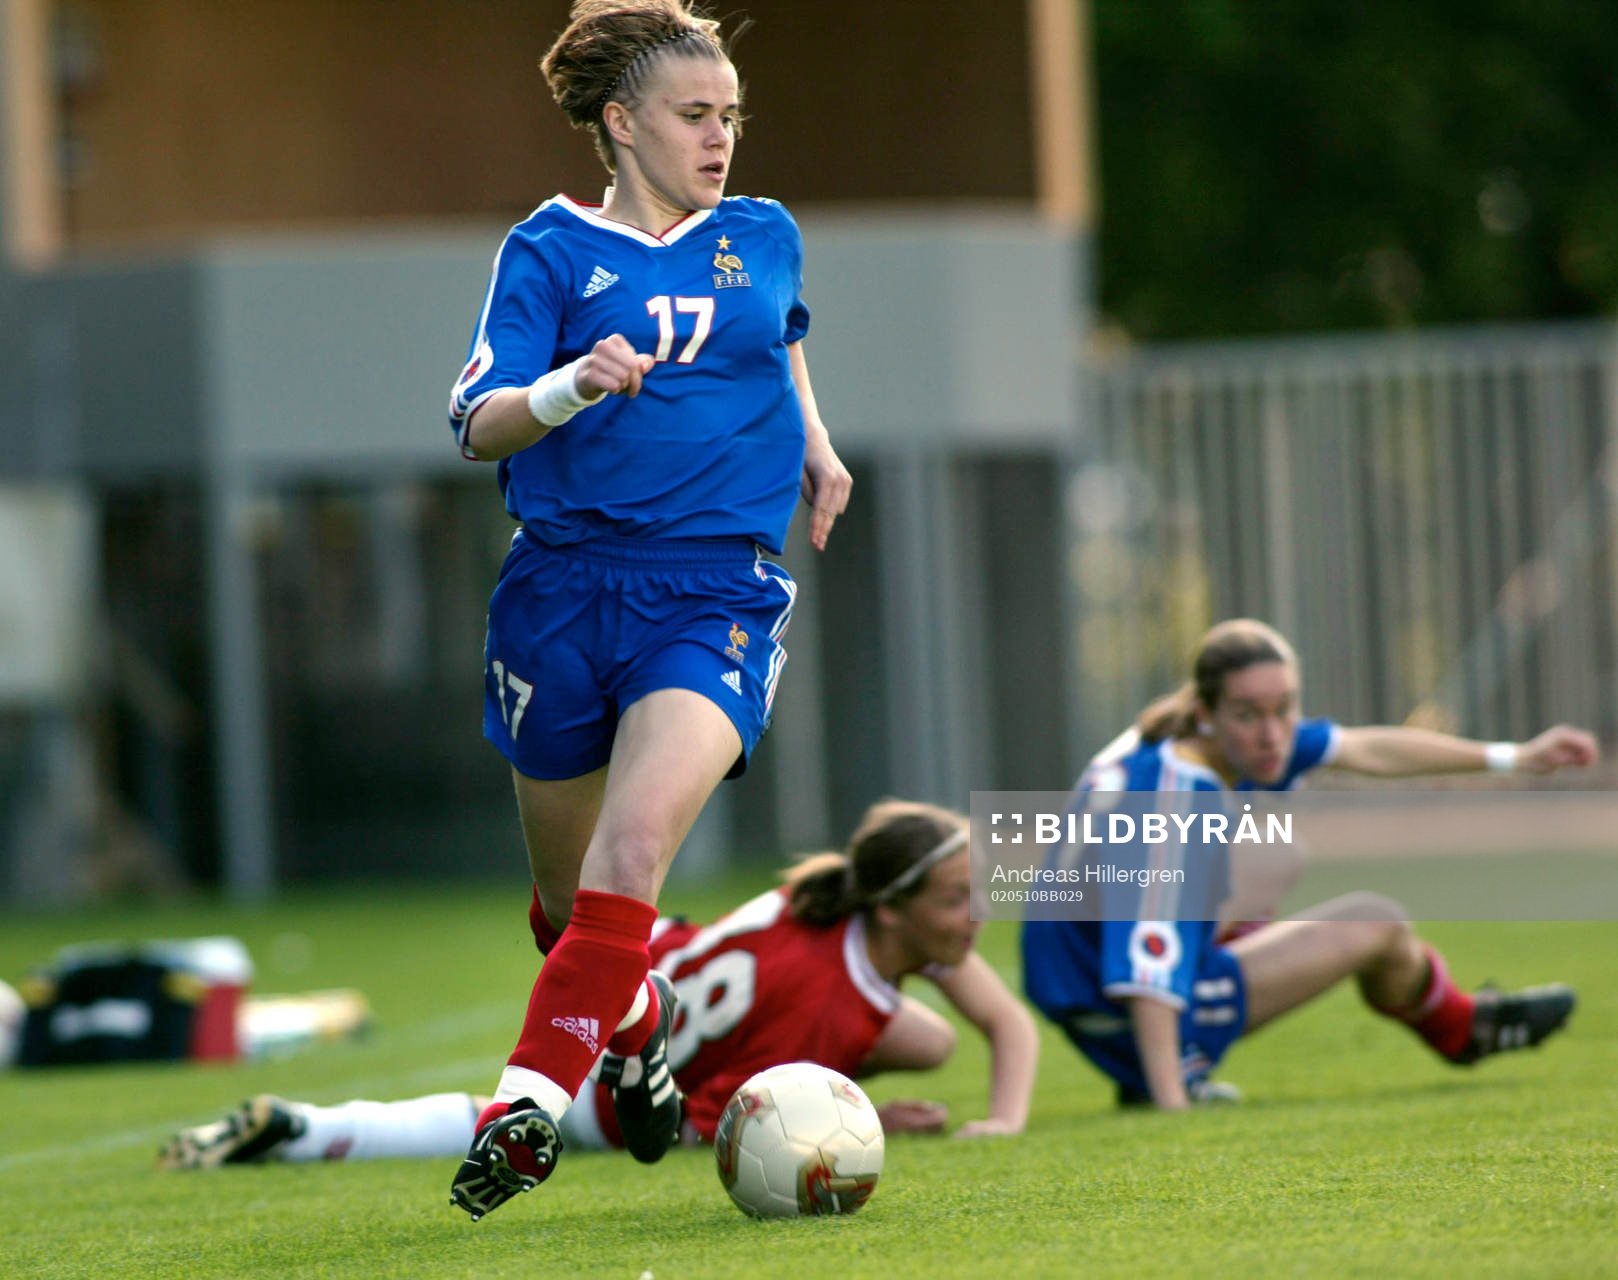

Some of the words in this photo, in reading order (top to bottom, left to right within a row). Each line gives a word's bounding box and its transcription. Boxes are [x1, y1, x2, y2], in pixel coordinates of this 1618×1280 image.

[582, 273, 620, 298] adidas
[645, 294, 716, 364] 17
[492, 659, 534, 742] 17
[551, 1016, 599, 1055] adidas
